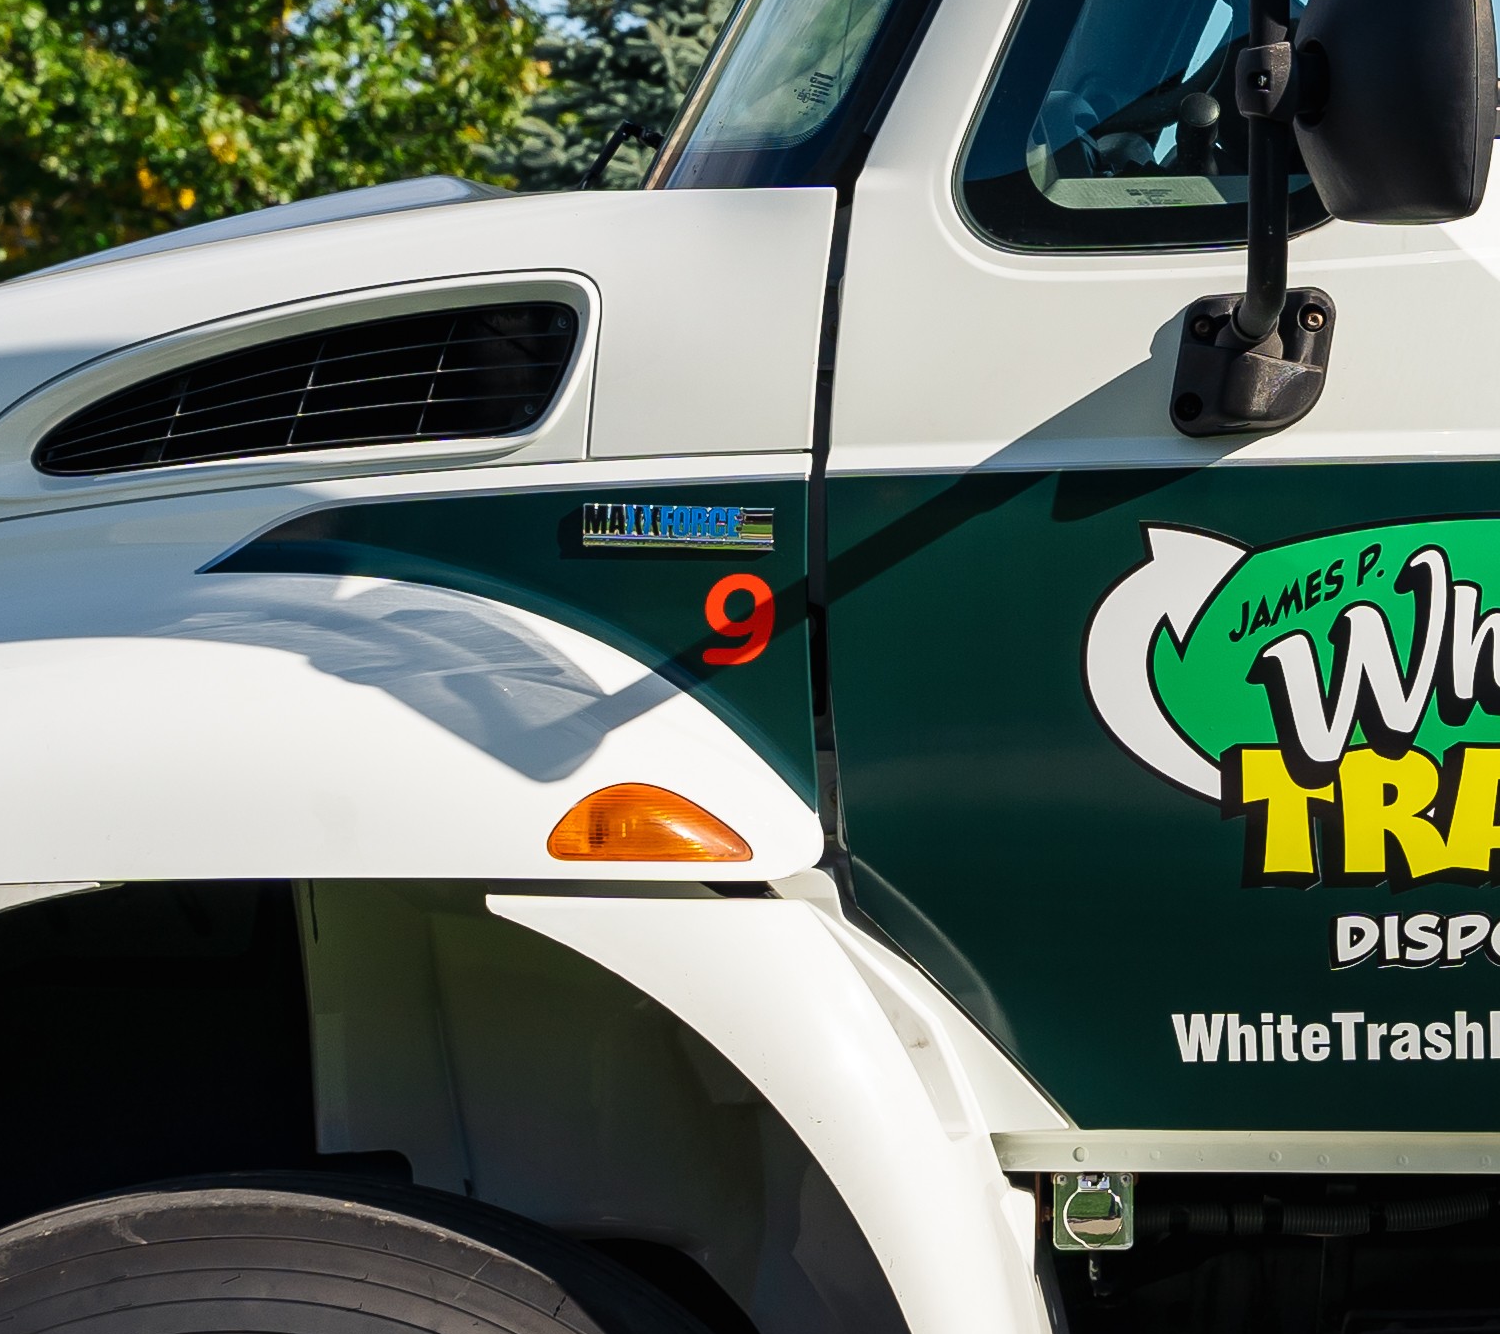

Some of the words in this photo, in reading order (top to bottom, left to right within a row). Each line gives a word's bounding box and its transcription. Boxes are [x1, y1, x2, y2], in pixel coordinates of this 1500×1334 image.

[702, 572, 775, 666] 9
[1229, 567, 1345, 643] JAMES
[1355, 543, 1387, 588] P.
